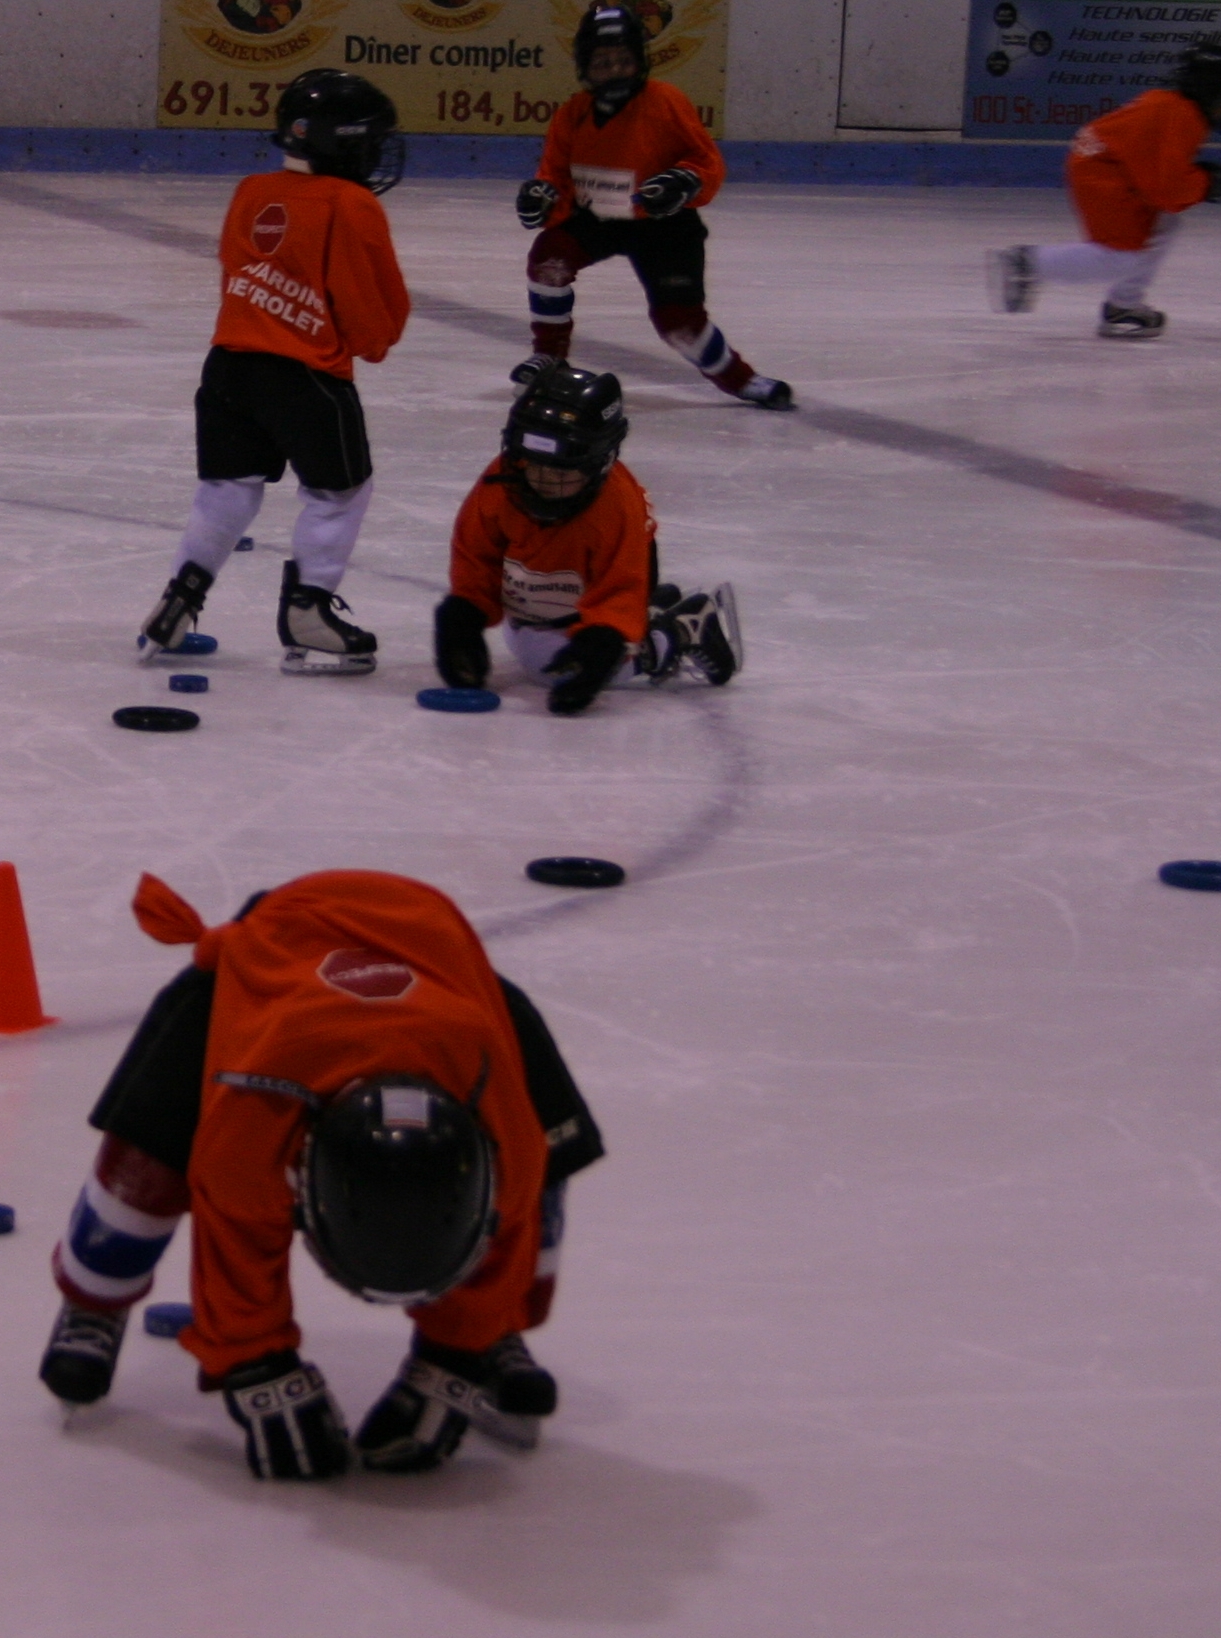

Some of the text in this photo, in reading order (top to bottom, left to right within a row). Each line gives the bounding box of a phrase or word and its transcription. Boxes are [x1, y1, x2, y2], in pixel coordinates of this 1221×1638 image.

[1081, 5, 1220, 22] TECHNOLOGIE
[205, 29, 312, 62] DEJEUNERS
[1068, 27, 1135, 42] Haute
[344, 35, 544, 72] Dîner complet
[1057, 49, 1123, 64] Haute
[1047, 70, 1113, 85] Haute
[163, 80, 293, 117] 691.3
[436, 89, 504, 126] 184,
